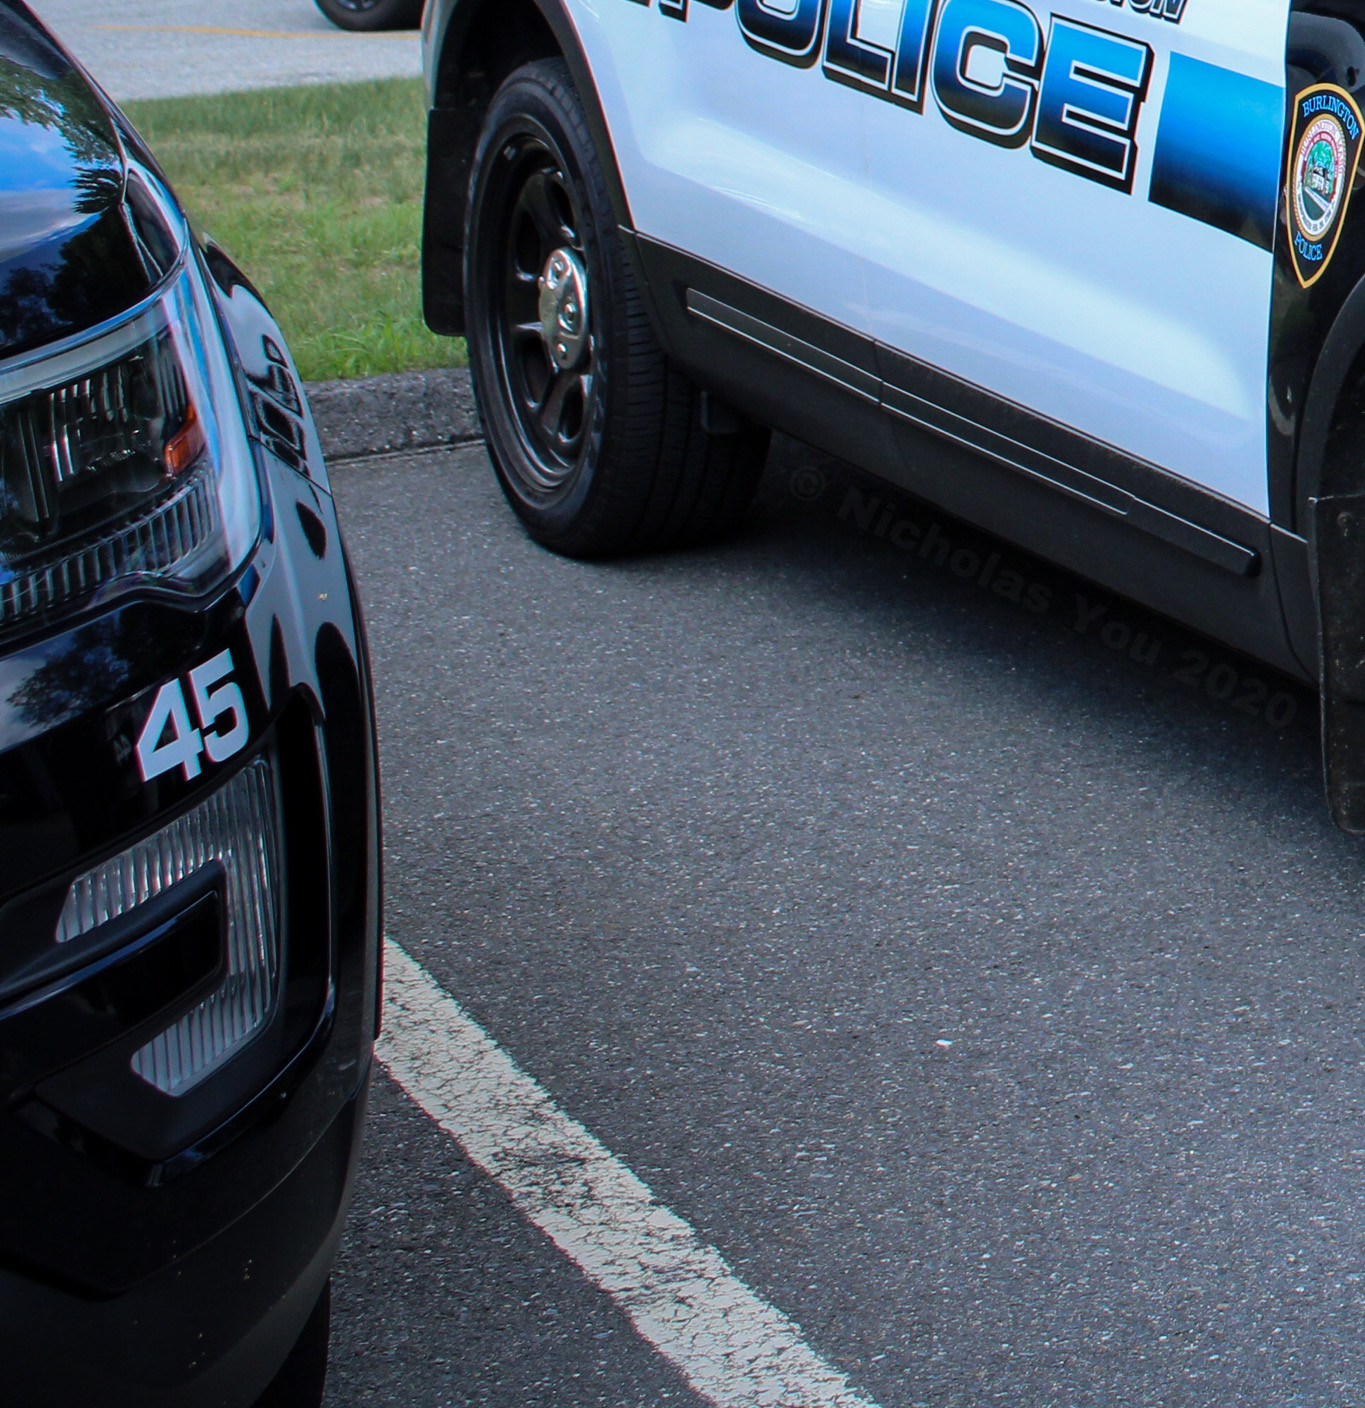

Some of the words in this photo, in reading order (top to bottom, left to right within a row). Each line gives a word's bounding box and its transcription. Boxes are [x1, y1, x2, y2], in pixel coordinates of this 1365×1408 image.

[1301, 94, 1360, 140] BURLINGTON
[1293, 230, 1323, 262] POLICE
[134, 647, 250, 783] 45
